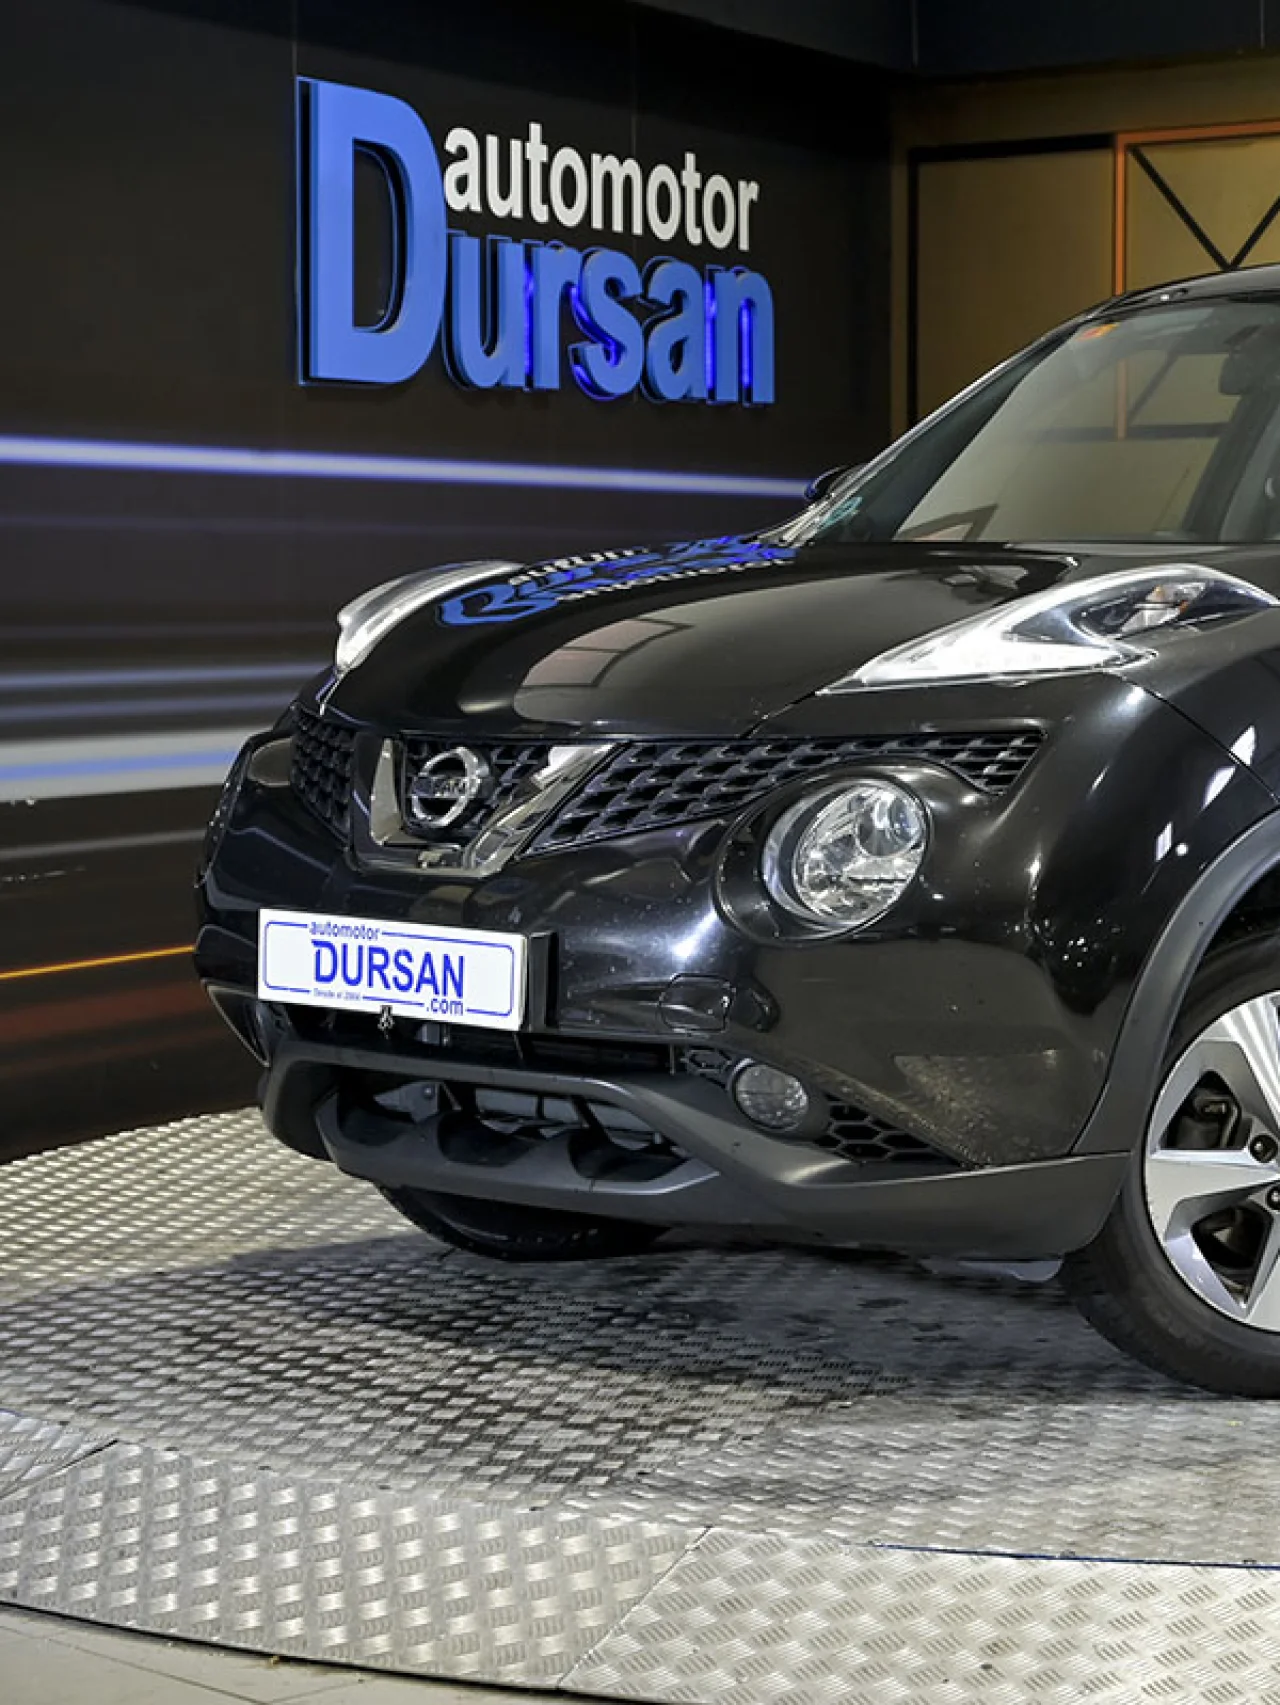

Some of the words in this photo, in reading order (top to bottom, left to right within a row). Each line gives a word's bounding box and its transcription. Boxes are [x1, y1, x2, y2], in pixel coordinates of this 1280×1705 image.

[444, 122, 759, 252] automotor
[296, 75, 775, 405] Dursan
[308, 921, 380, 941] automotor
[311, 938, 465, 999] DURSAN
[426, 997, 464, 1016] .com
